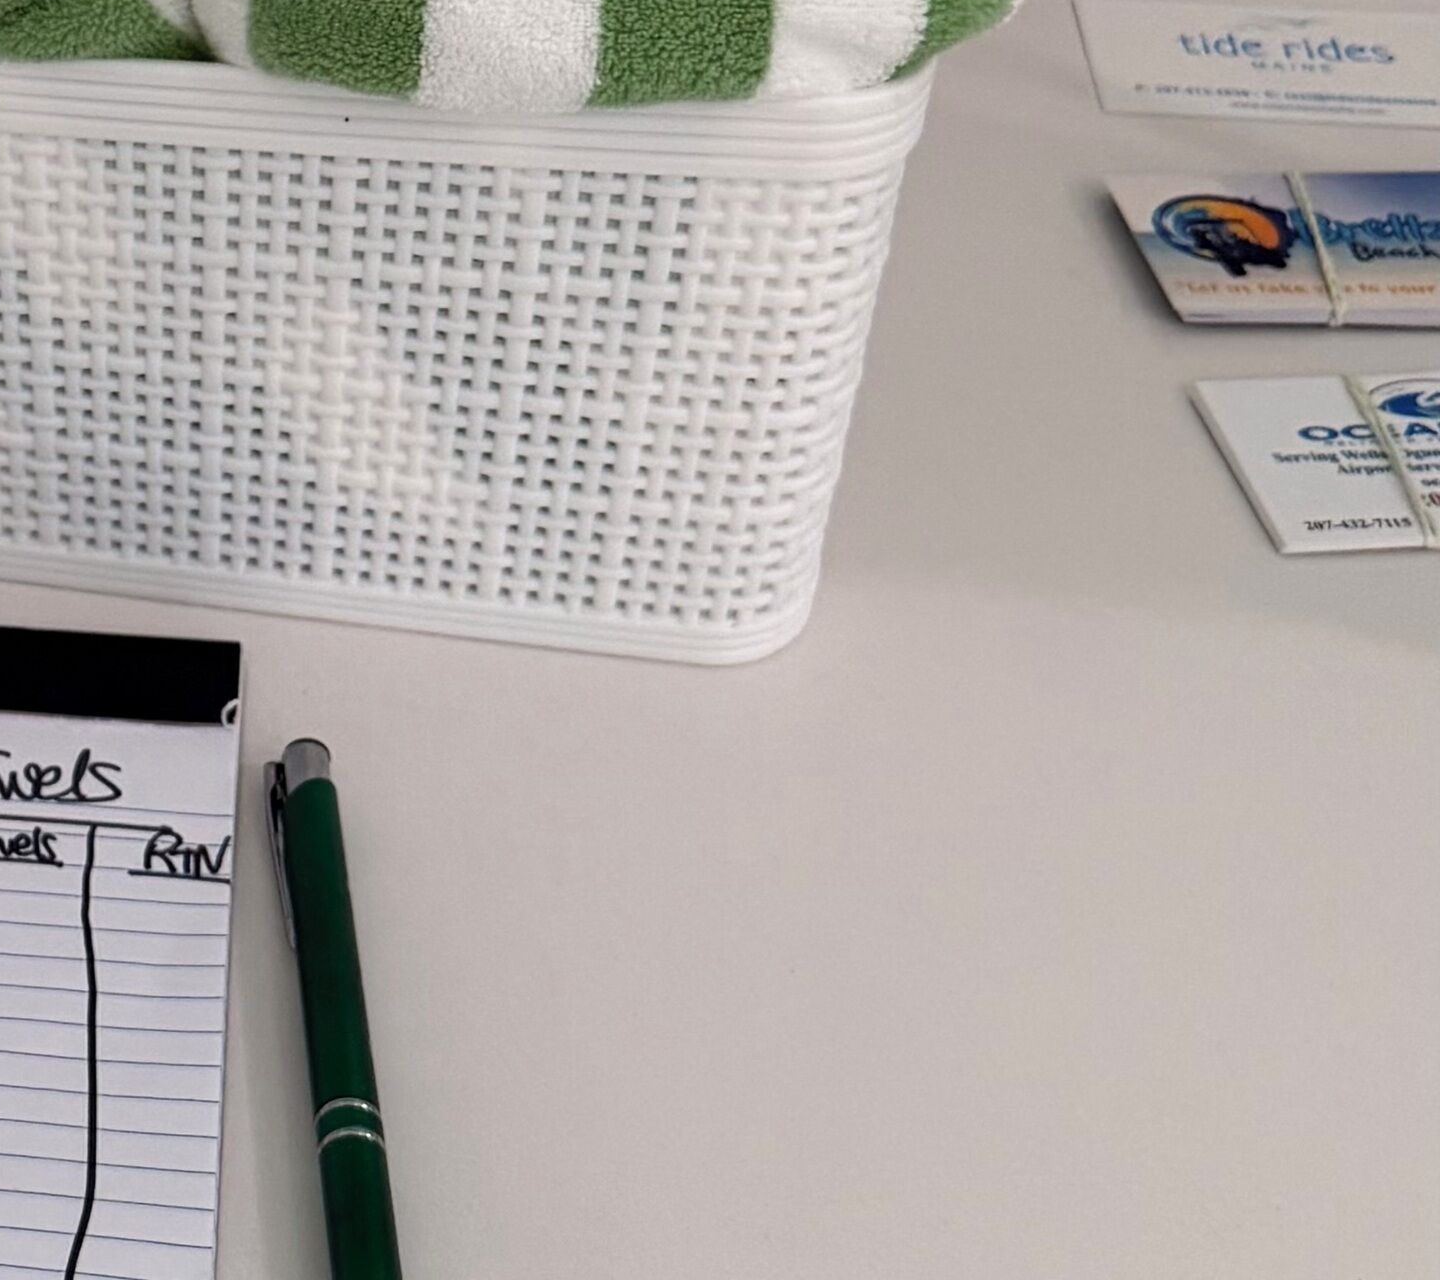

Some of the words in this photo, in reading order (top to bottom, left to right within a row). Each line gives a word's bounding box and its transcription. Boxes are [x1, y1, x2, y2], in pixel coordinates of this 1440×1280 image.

[1178, 32, 1262, 58] tide
[1282, 36, 1394, 65] rides
[142, 830, 232, 878] RTN
